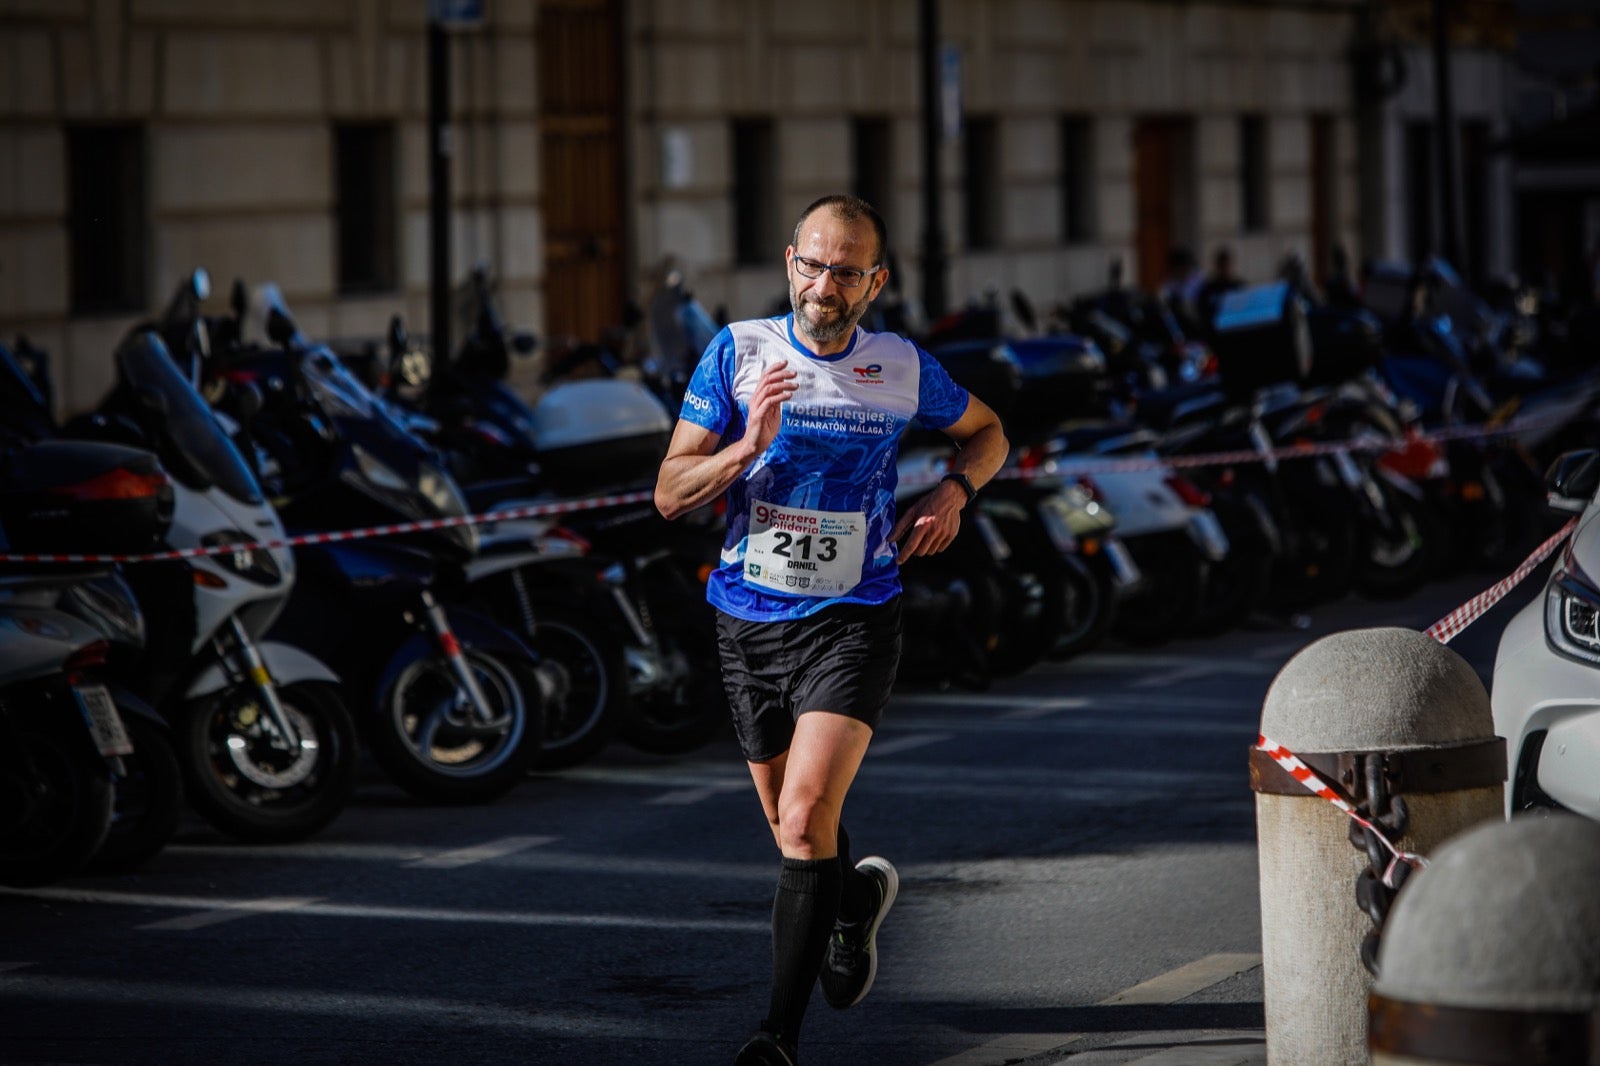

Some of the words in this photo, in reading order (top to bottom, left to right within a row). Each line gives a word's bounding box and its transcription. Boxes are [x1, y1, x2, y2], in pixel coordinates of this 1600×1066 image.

[786, 418, 800, 428] 1/2
[801, 420, 847, 432] MARATÓN
[849, 423, 884, 435] MÁLAGA
[769, 509, 817, 525] Carrera
[769, 518, 819, 535] Solidaria
[772, 531, 838, 562] 213
[787, 560, 819, 572] DANIEL
